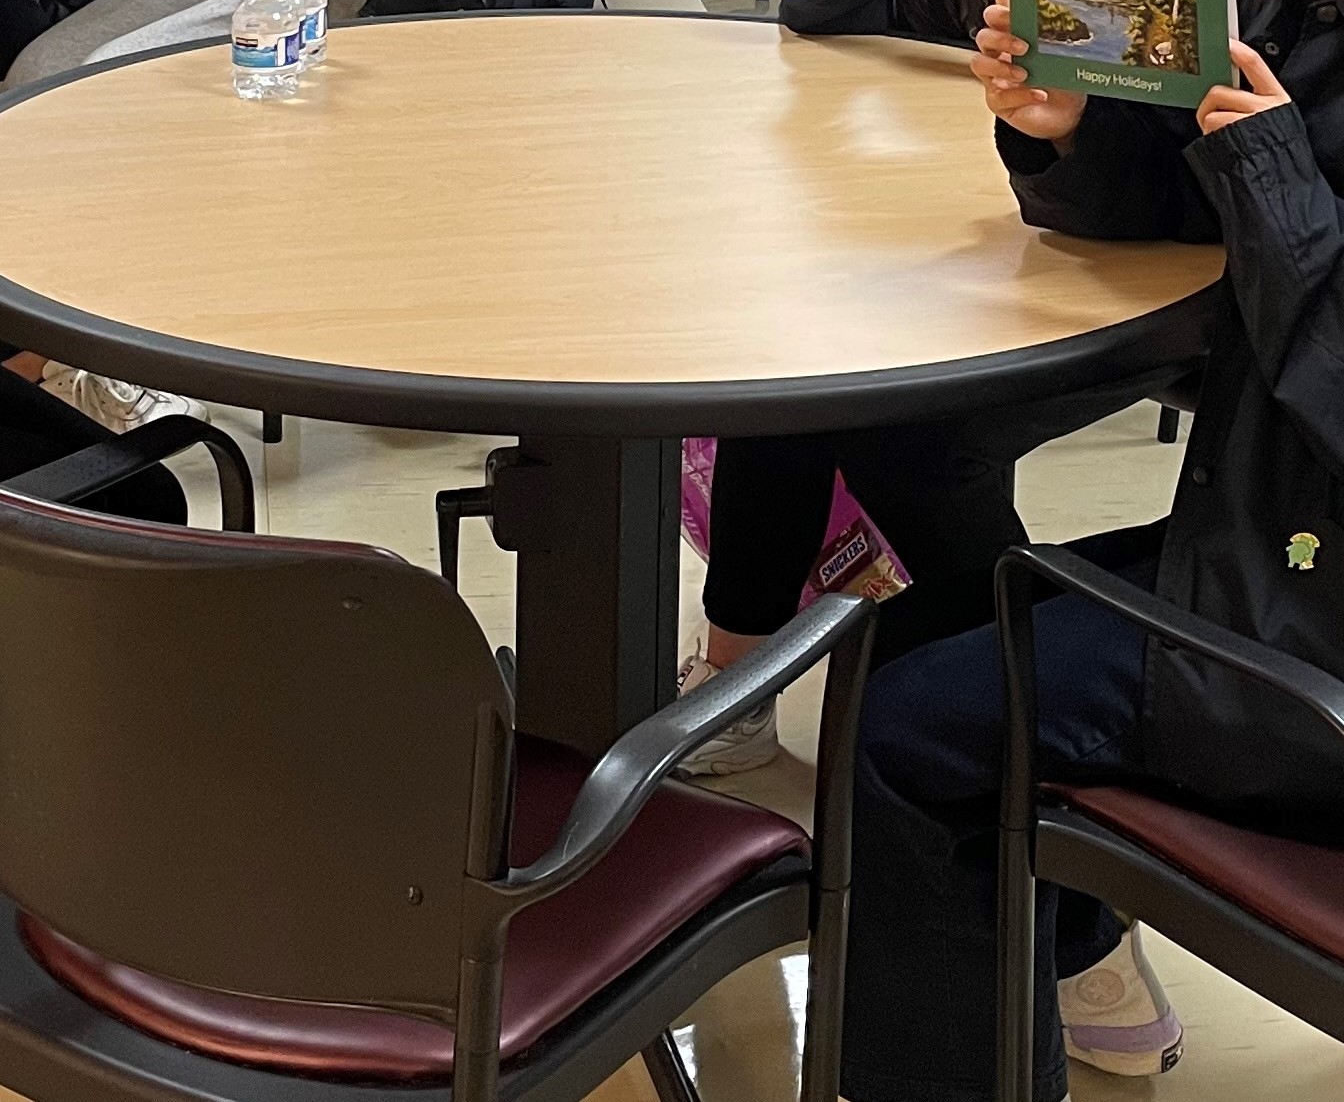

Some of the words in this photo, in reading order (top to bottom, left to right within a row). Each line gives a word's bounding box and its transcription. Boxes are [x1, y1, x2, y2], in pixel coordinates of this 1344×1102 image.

[1076, 67, 1111, 86] Happy
[1113, 73, 1163, 93] Holidays!
[821, 535, 866, 583] SNICKERS
